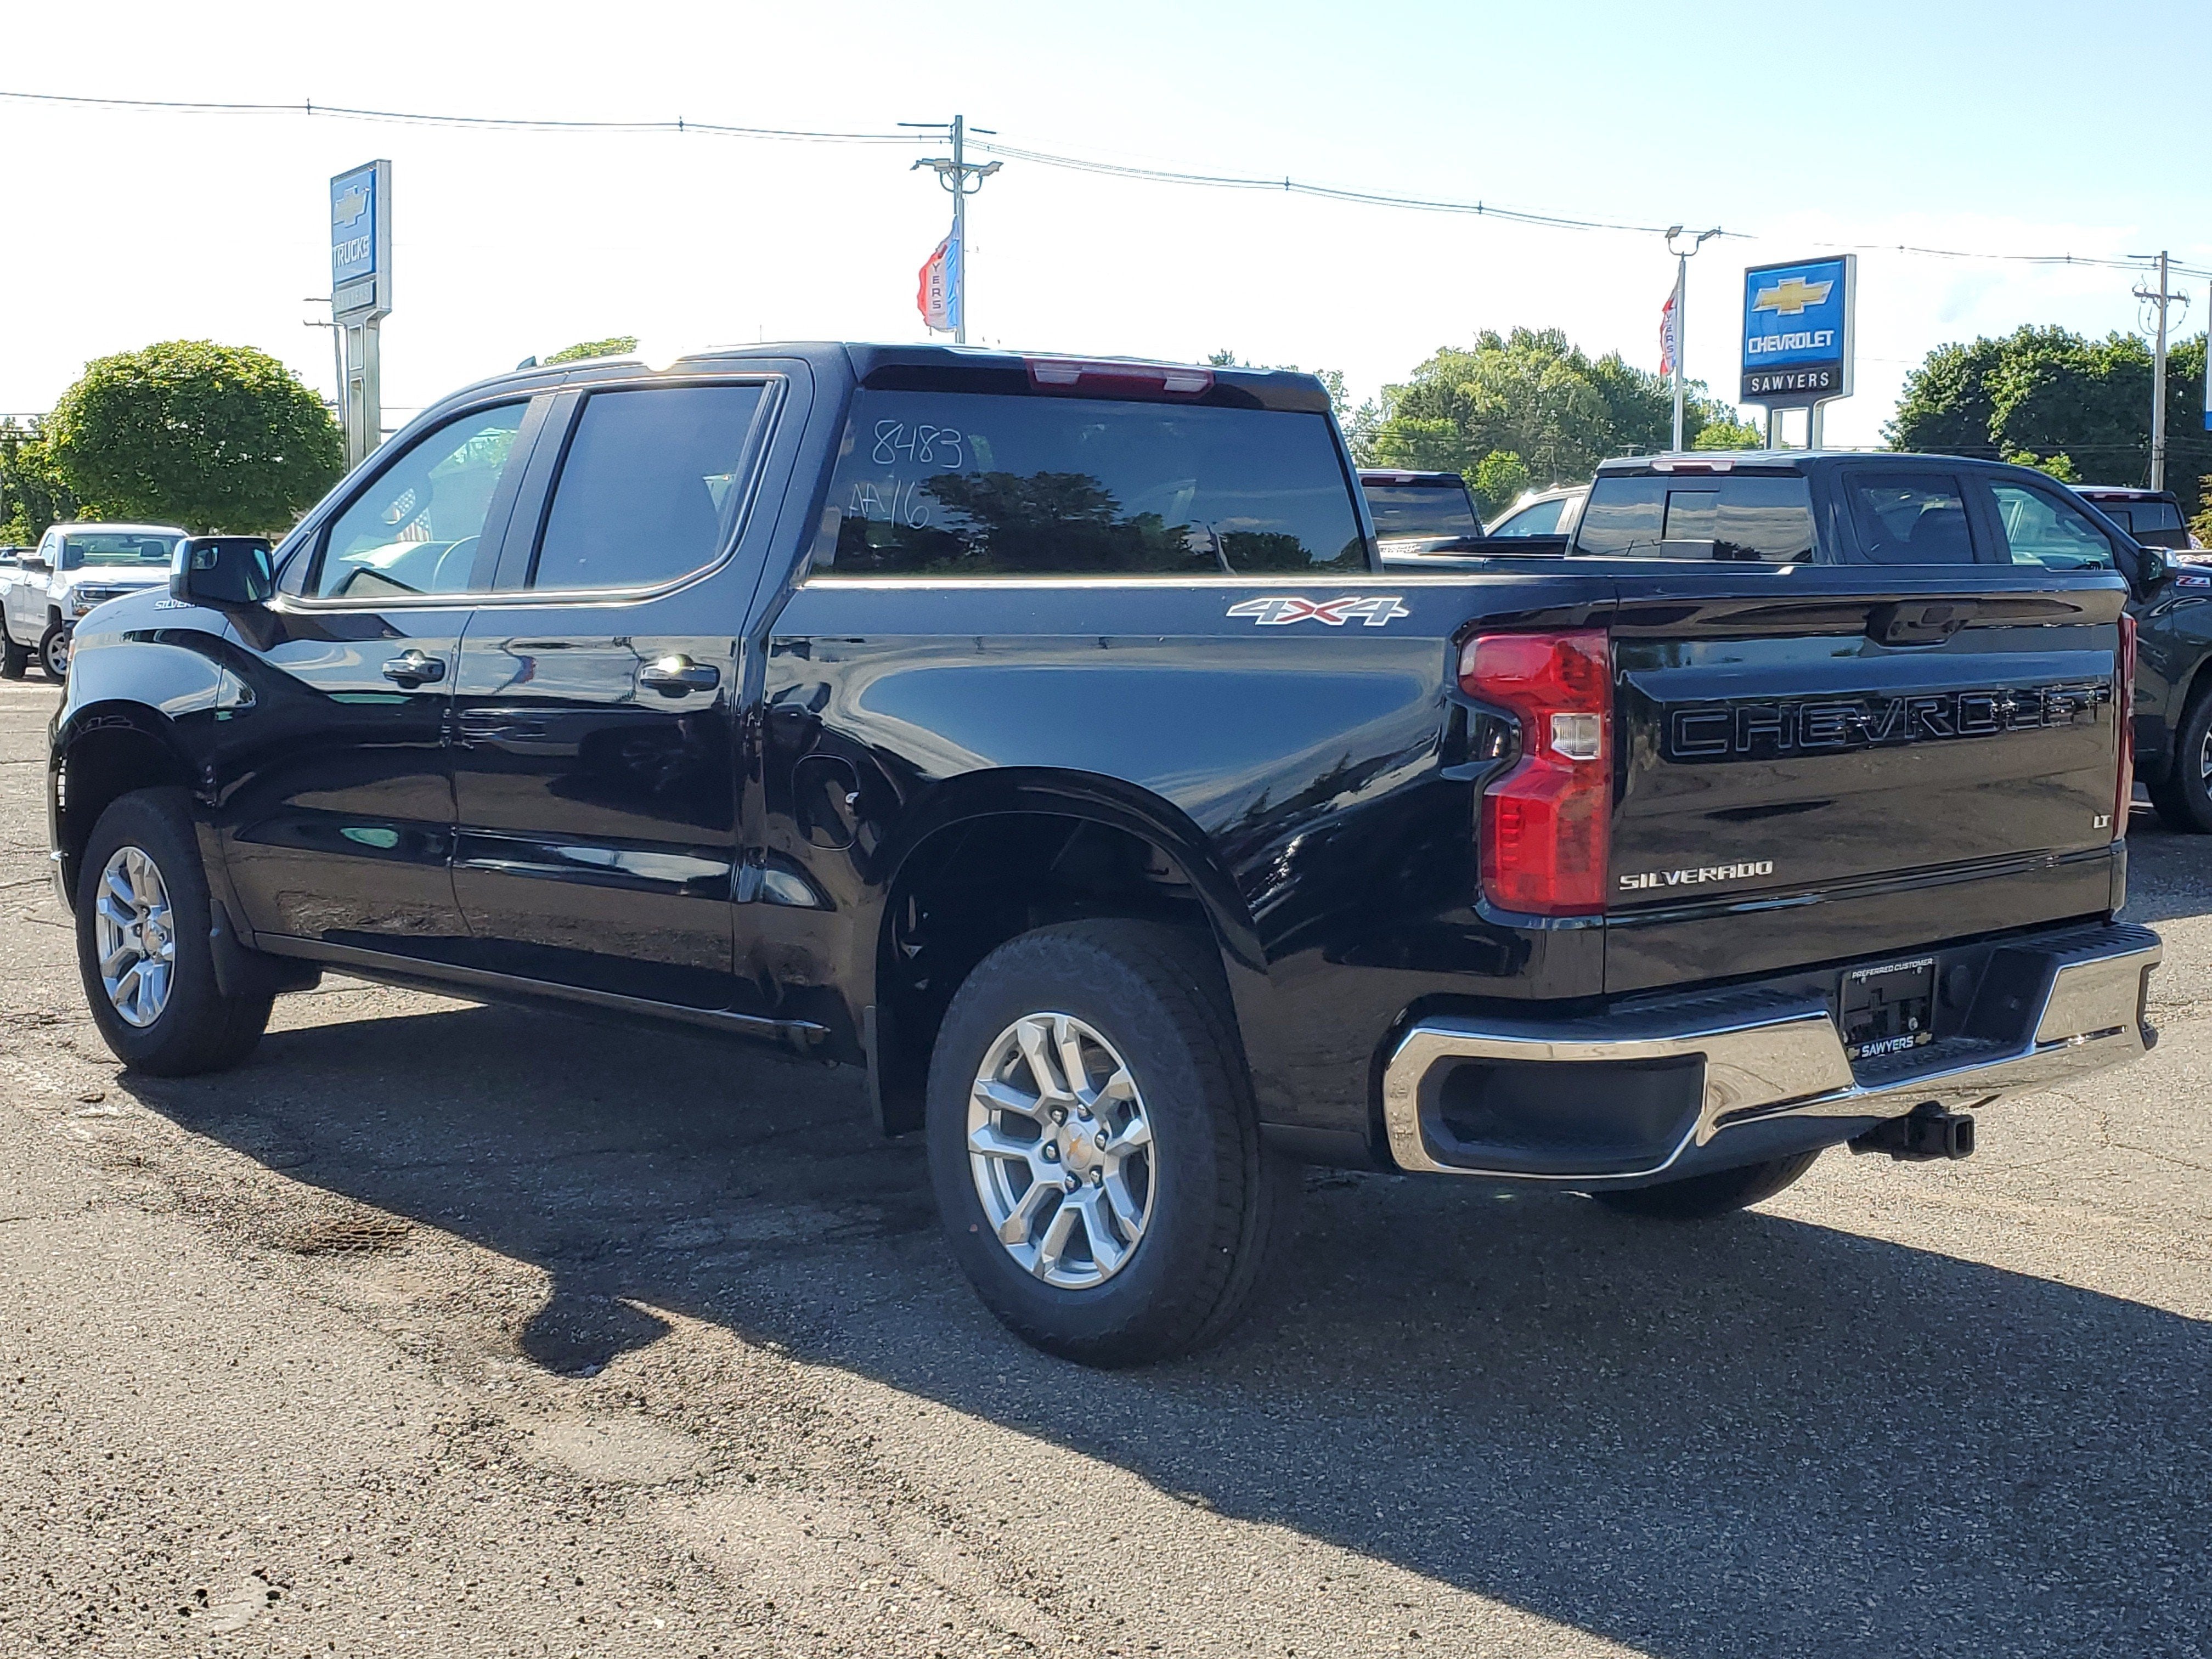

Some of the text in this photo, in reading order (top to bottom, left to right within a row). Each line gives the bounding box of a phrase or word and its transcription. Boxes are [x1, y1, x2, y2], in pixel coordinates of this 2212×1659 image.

[333, 235, 370, 268] TRUCKS
[1748, 330, 1834, 354] CHEVROLET
[1752, 372, 1830, 392] SAWYERS
[872, 420, 962, 469] 8483
[1671, 681, 2110, 756] CHEVROLET
[2094, 815, 2111, 828] LT
[1619, 860, 1773, 890] SILVERADO
[1852, 958, 1933, 979] PREFERRED CUSTOMER
[1861, 1035, 1914, 1058] SAWYERS
